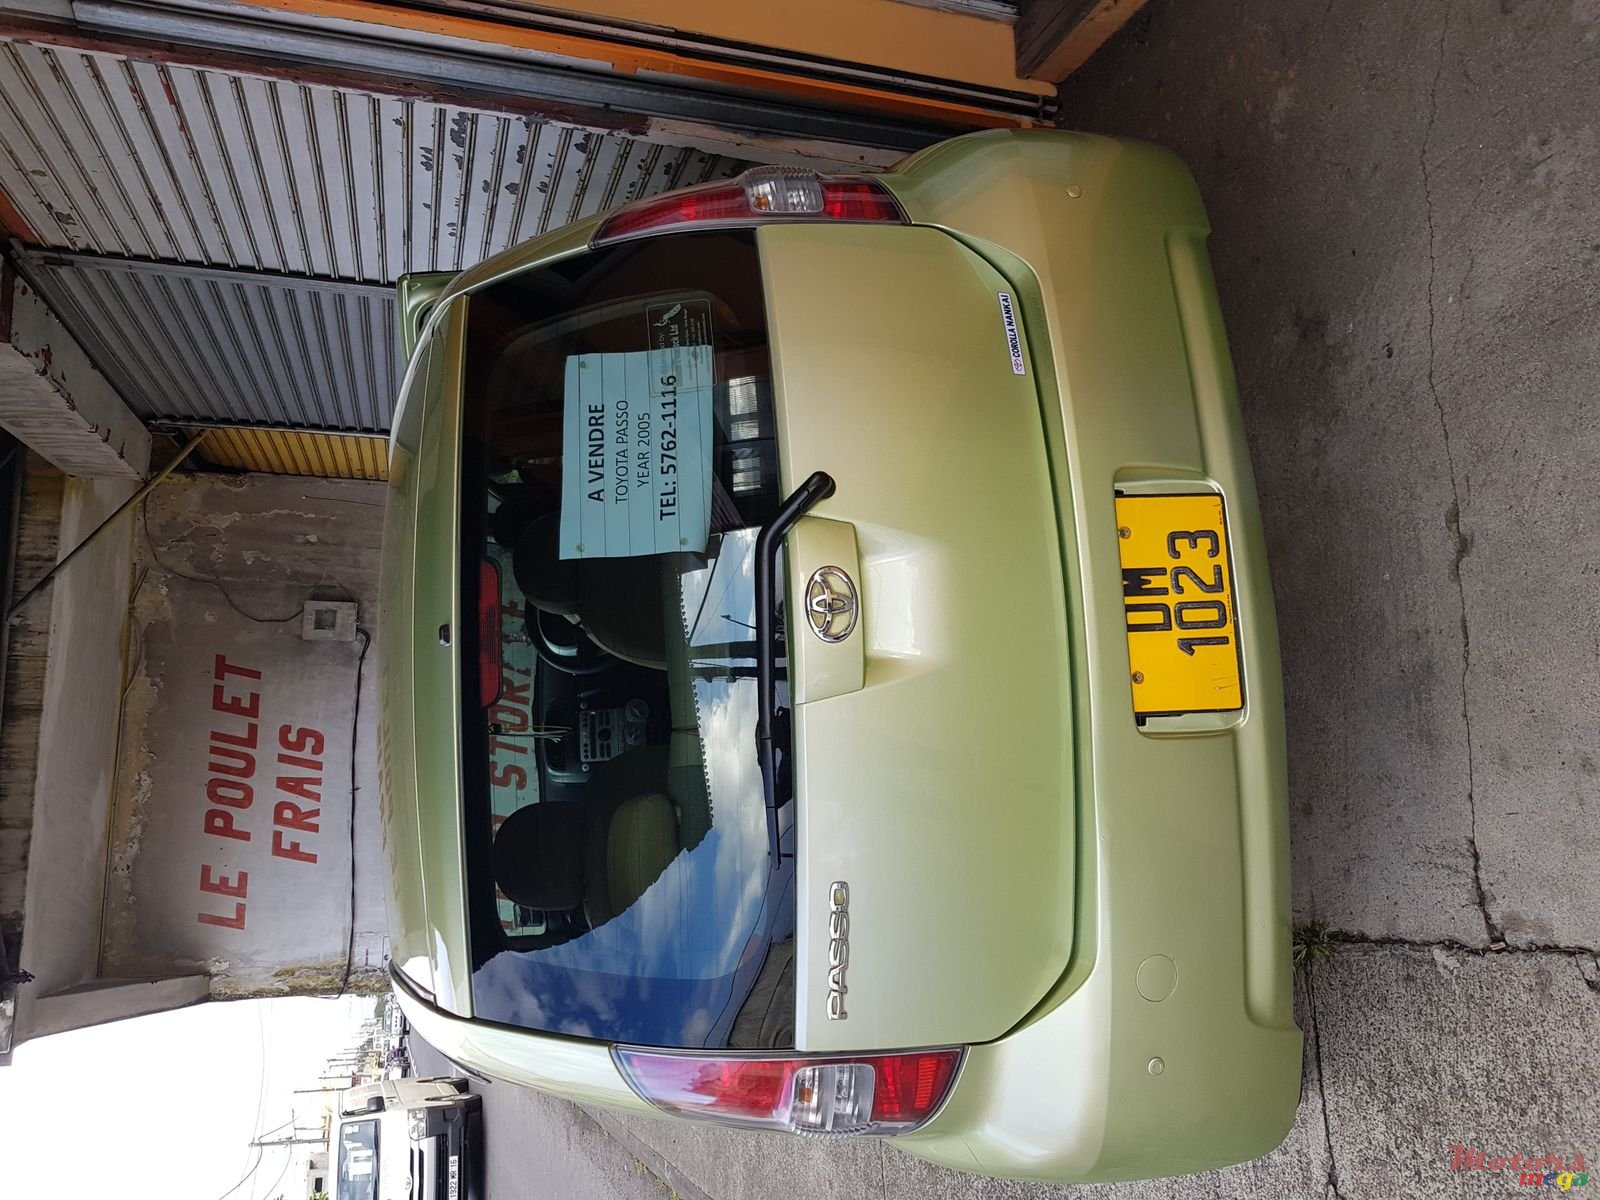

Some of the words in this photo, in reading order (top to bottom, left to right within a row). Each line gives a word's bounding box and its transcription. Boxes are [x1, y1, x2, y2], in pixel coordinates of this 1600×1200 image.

[1000, 294, 1014, 327] NANKAI
[1007, 328, 1021, 358] COROLLA
[588, 403, 605, 484] VENDRE
[615, 400, 629, 444] PASSO
[636, 412, 650, 447] 2005
[659, 374, 677, 475] 5762-1116
[588, 489, 605, 503] A
[615, 448, 629, 504] TOYOTA
[637, 451, 650, 488] YEAR
[660, 481, 677, 521] TEL:
[1121, 566, 1172, 633] DM
[1167, 529, 1229, 657] 1023
[203, 654, 262, 842] POULET
[271, 724, 325, 865] FRAIS
[197, 864, 249, 931] LE
[825, 880, 850, 1021] PASSO
